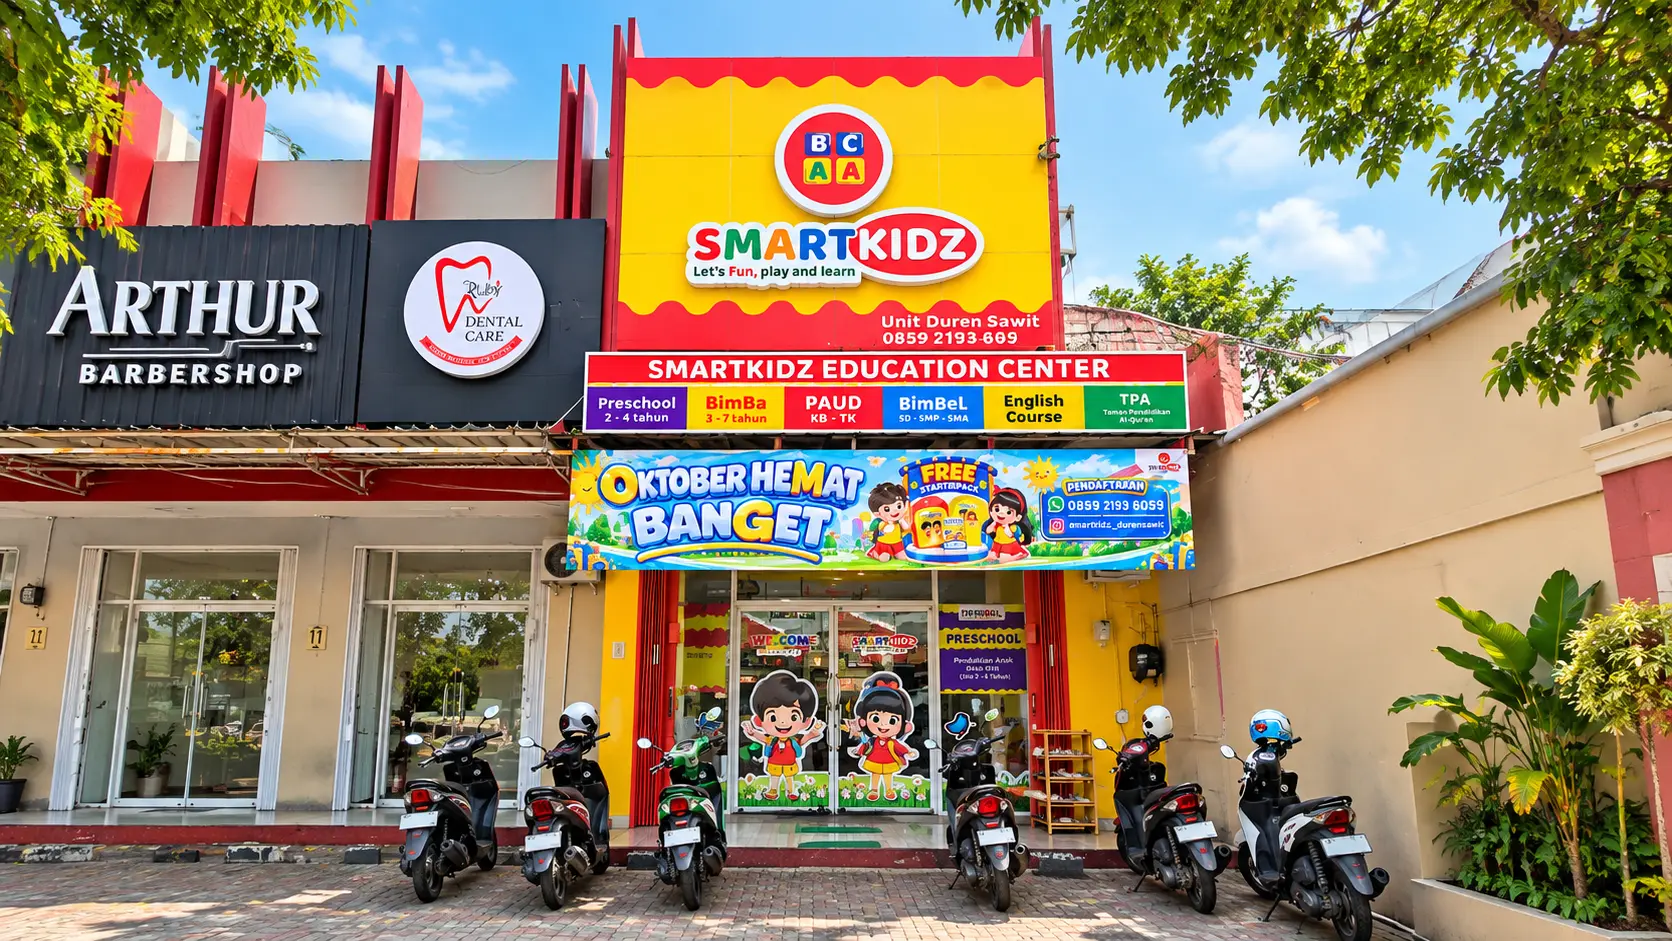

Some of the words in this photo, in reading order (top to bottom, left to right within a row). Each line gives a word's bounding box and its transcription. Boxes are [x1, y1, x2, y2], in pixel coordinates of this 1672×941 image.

[694, 266, 726, 277] Let's
[729, 266, 758, 279] Fun,
[761, 266, 789, 280] play
[792, 266, 818, 277] and
[821, 266, 856, 277] learn
[47, 265, 321, 336] ARTHUR
[465, 316, 523, 328] DENTAL
[881, 314, 920, 328] Unit
[926, 315, 982, 328] Duren
[987, 314, 1040, 328] Sawit
[465, 330, 504, 342] CARE
[882, 331, 928, 344] 0859
[79, 364, 304, 386] BARBERSHOP
[648, 359, 812, 379] SMARTKIDZ
[822, 359, 988, 379] EDUCATION
[998, 359, 1110, 379] CENTER
[598, 396, 676, 410] Preschool
[706, 396, 766, 410] BimBa
[805, 395, 862, 411] PAUD
[899, 396, 968, 411] BimBeL
[1004, 394, 1064, 410] English
[1119, 393, 1151, 406] TPA
[604, 413, 612, 422] 2
[622, 413, 630, 422] 4
[633, 413, 669, 422] tahun
[706, 414, 712, 423] 3
[722, 414, 729, 423] 7
[732, 413, 767, 423] tahun
[810, 413, 829, 423] KB
[840, 413, 857, 423] TK
[899, 414, 911, 422] SD
[919, 414, 940, 422] SMP
[948, 414, 969, 422] SMA
[1006, 411, 1062, 423] Course
[920, 462, 978, 484] FREE
[599, 464, 746, 505] OKTOBER
[751, 460, 865, 501] HEMAT
[1068, 500, 1100, 510] 0859
[633, 500, 832, 548] BANGET
[946, 634, 1021, 644] PRESCHOOL
